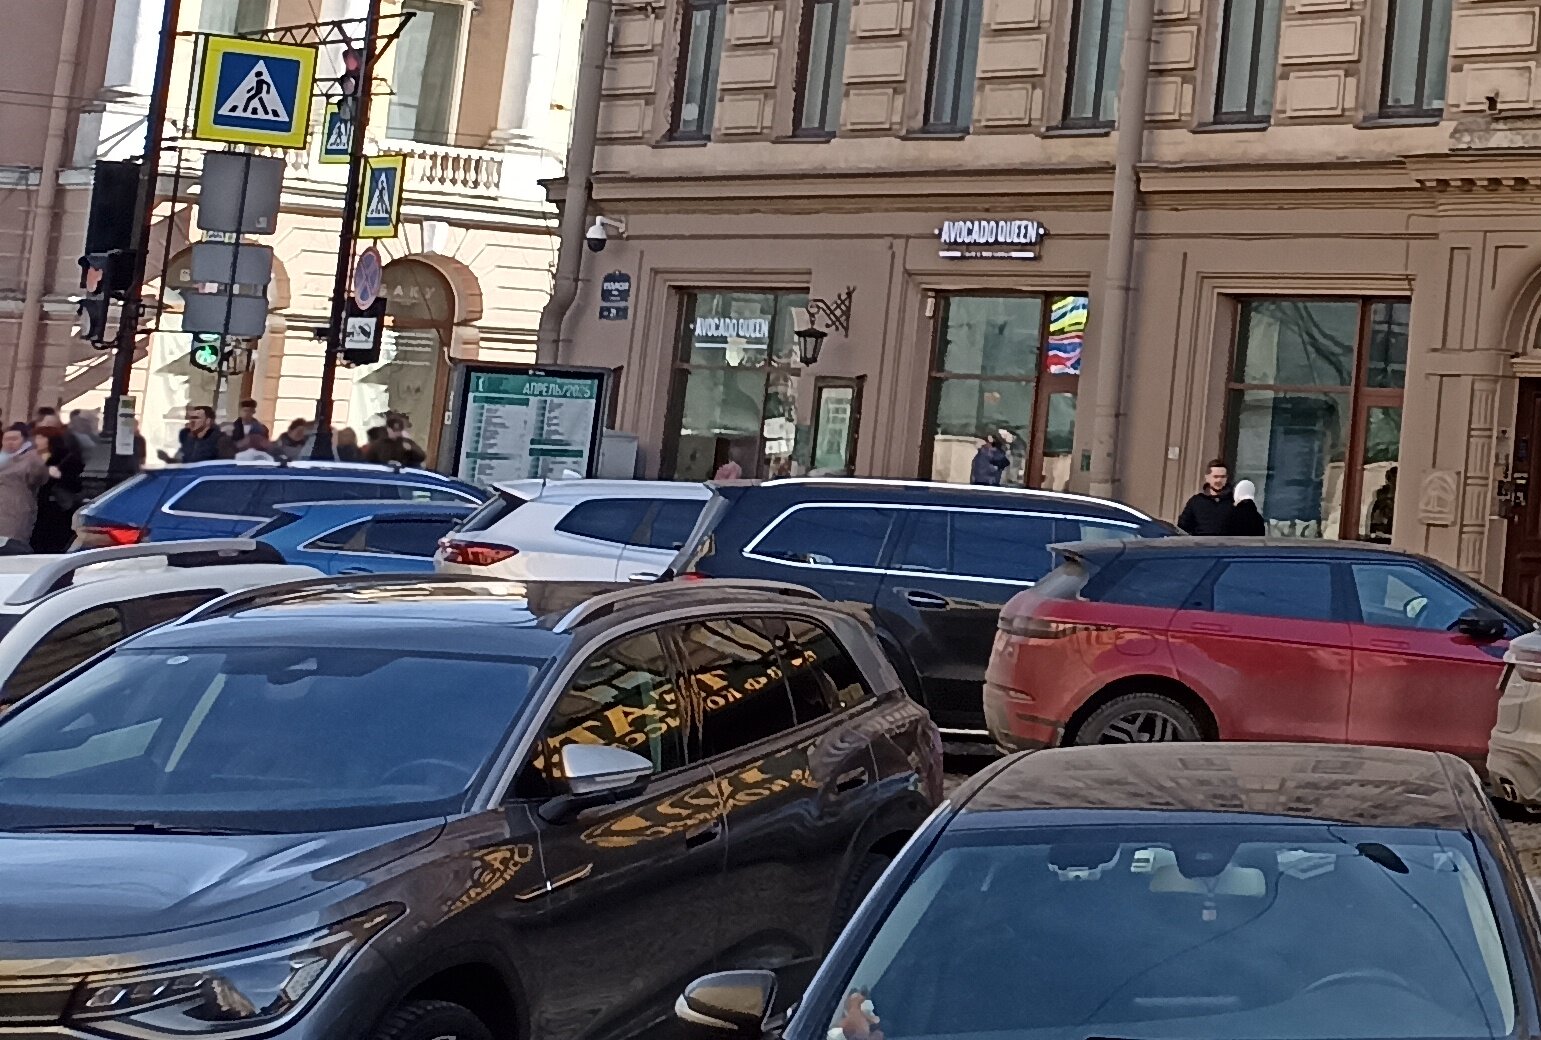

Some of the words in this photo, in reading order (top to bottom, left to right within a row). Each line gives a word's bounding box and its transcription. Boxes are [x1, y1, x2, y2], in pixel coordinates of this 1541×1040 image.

[941, 220, 997, 244] AVOCADO
[997, 220, 1037, 244] QUEEN
[695, 317, 737, 337] AVOCADO
[738, 318, 769, 338] QUEEN
